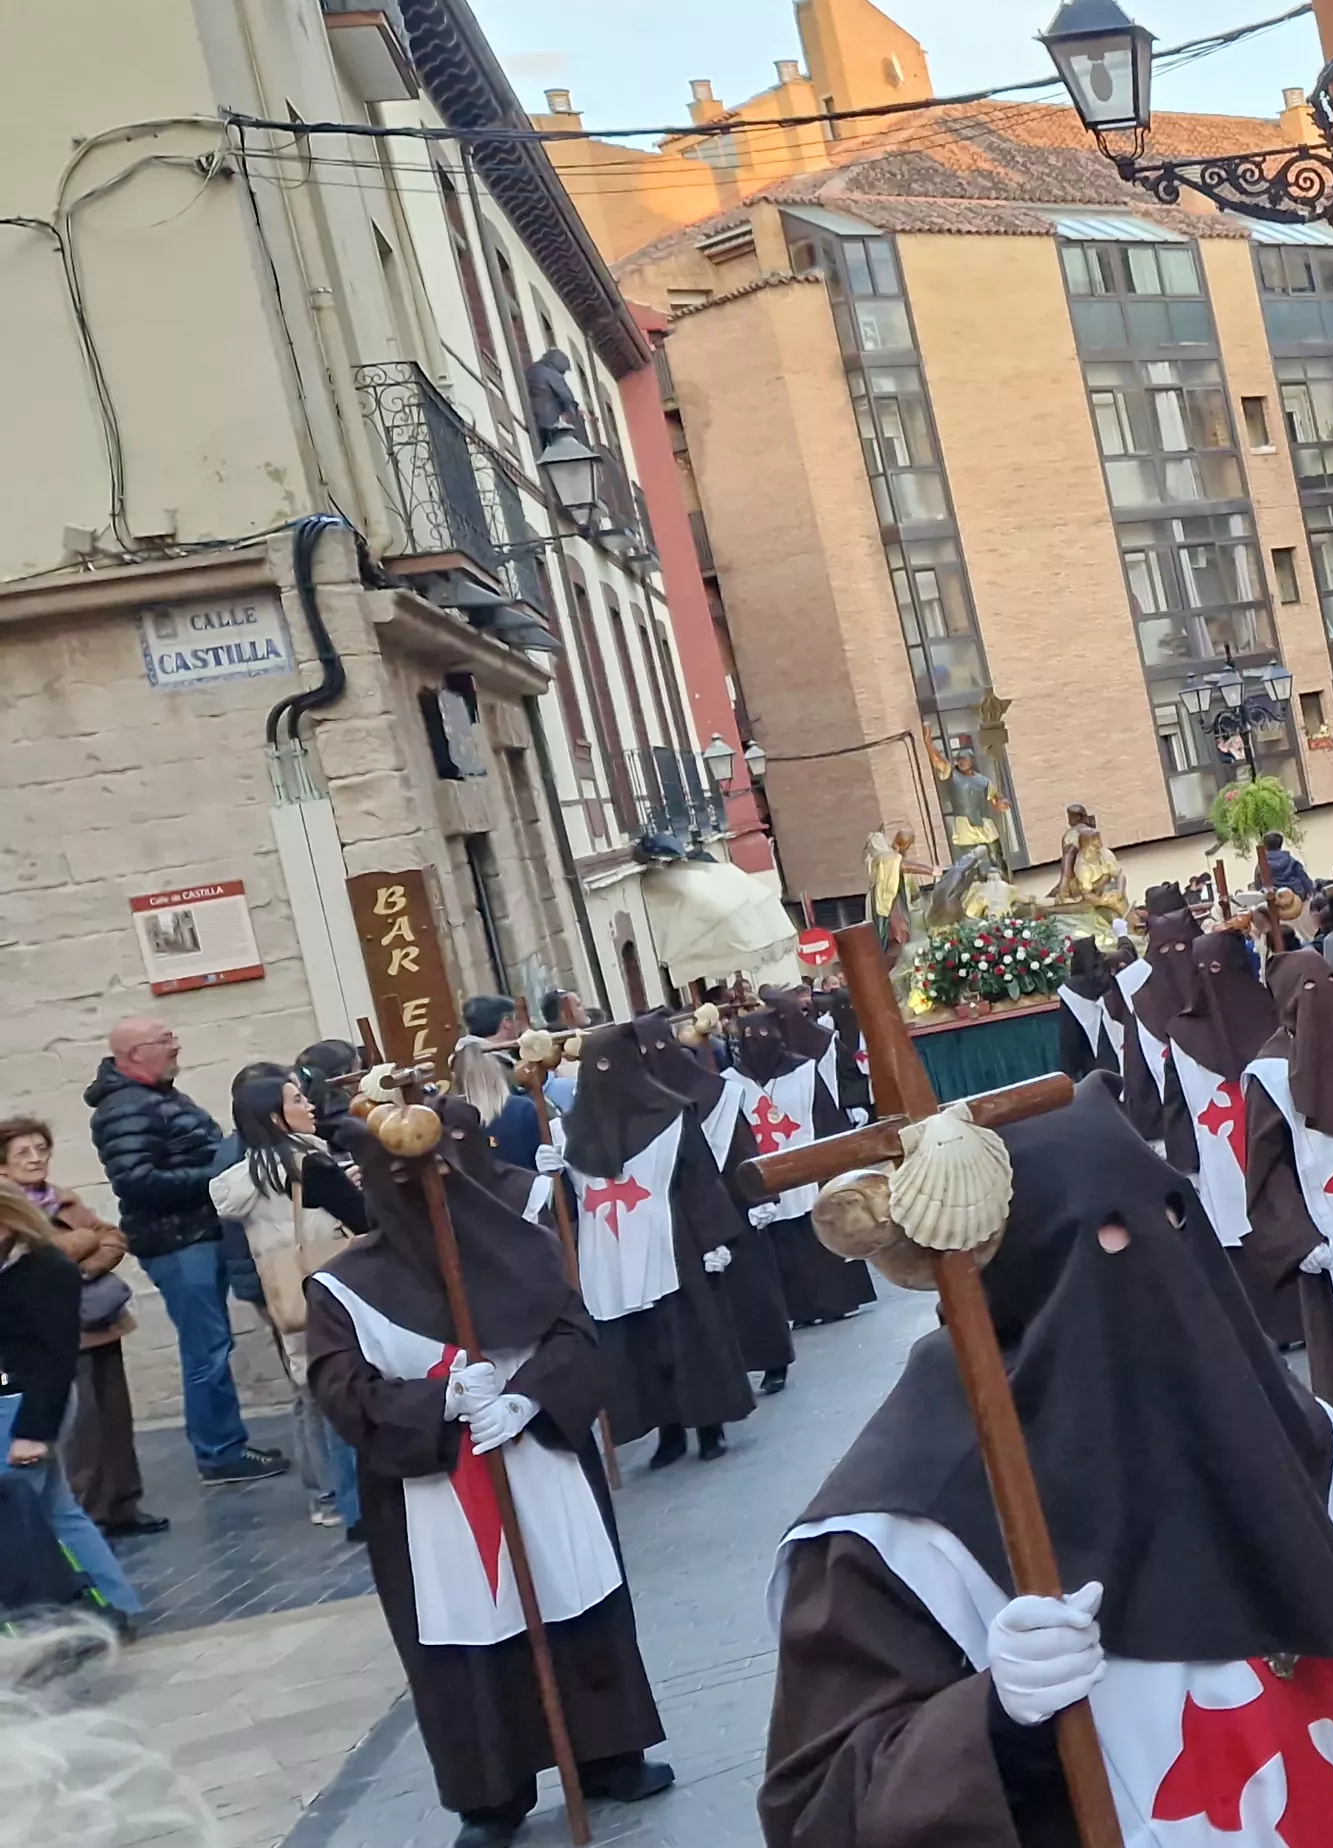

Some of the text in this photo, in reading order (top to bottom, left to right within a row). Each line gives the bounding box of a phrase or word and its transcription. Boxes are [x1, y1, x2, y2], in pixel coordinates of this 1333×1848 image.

[189, 606, 258, 631] CALLE
[157, 637, 283, 675] CASTILLA
[182, 885, 224, 900] CASTILLA
[373, 885, 421, 976] BAR
[402, 997, 438, 1058] EL
